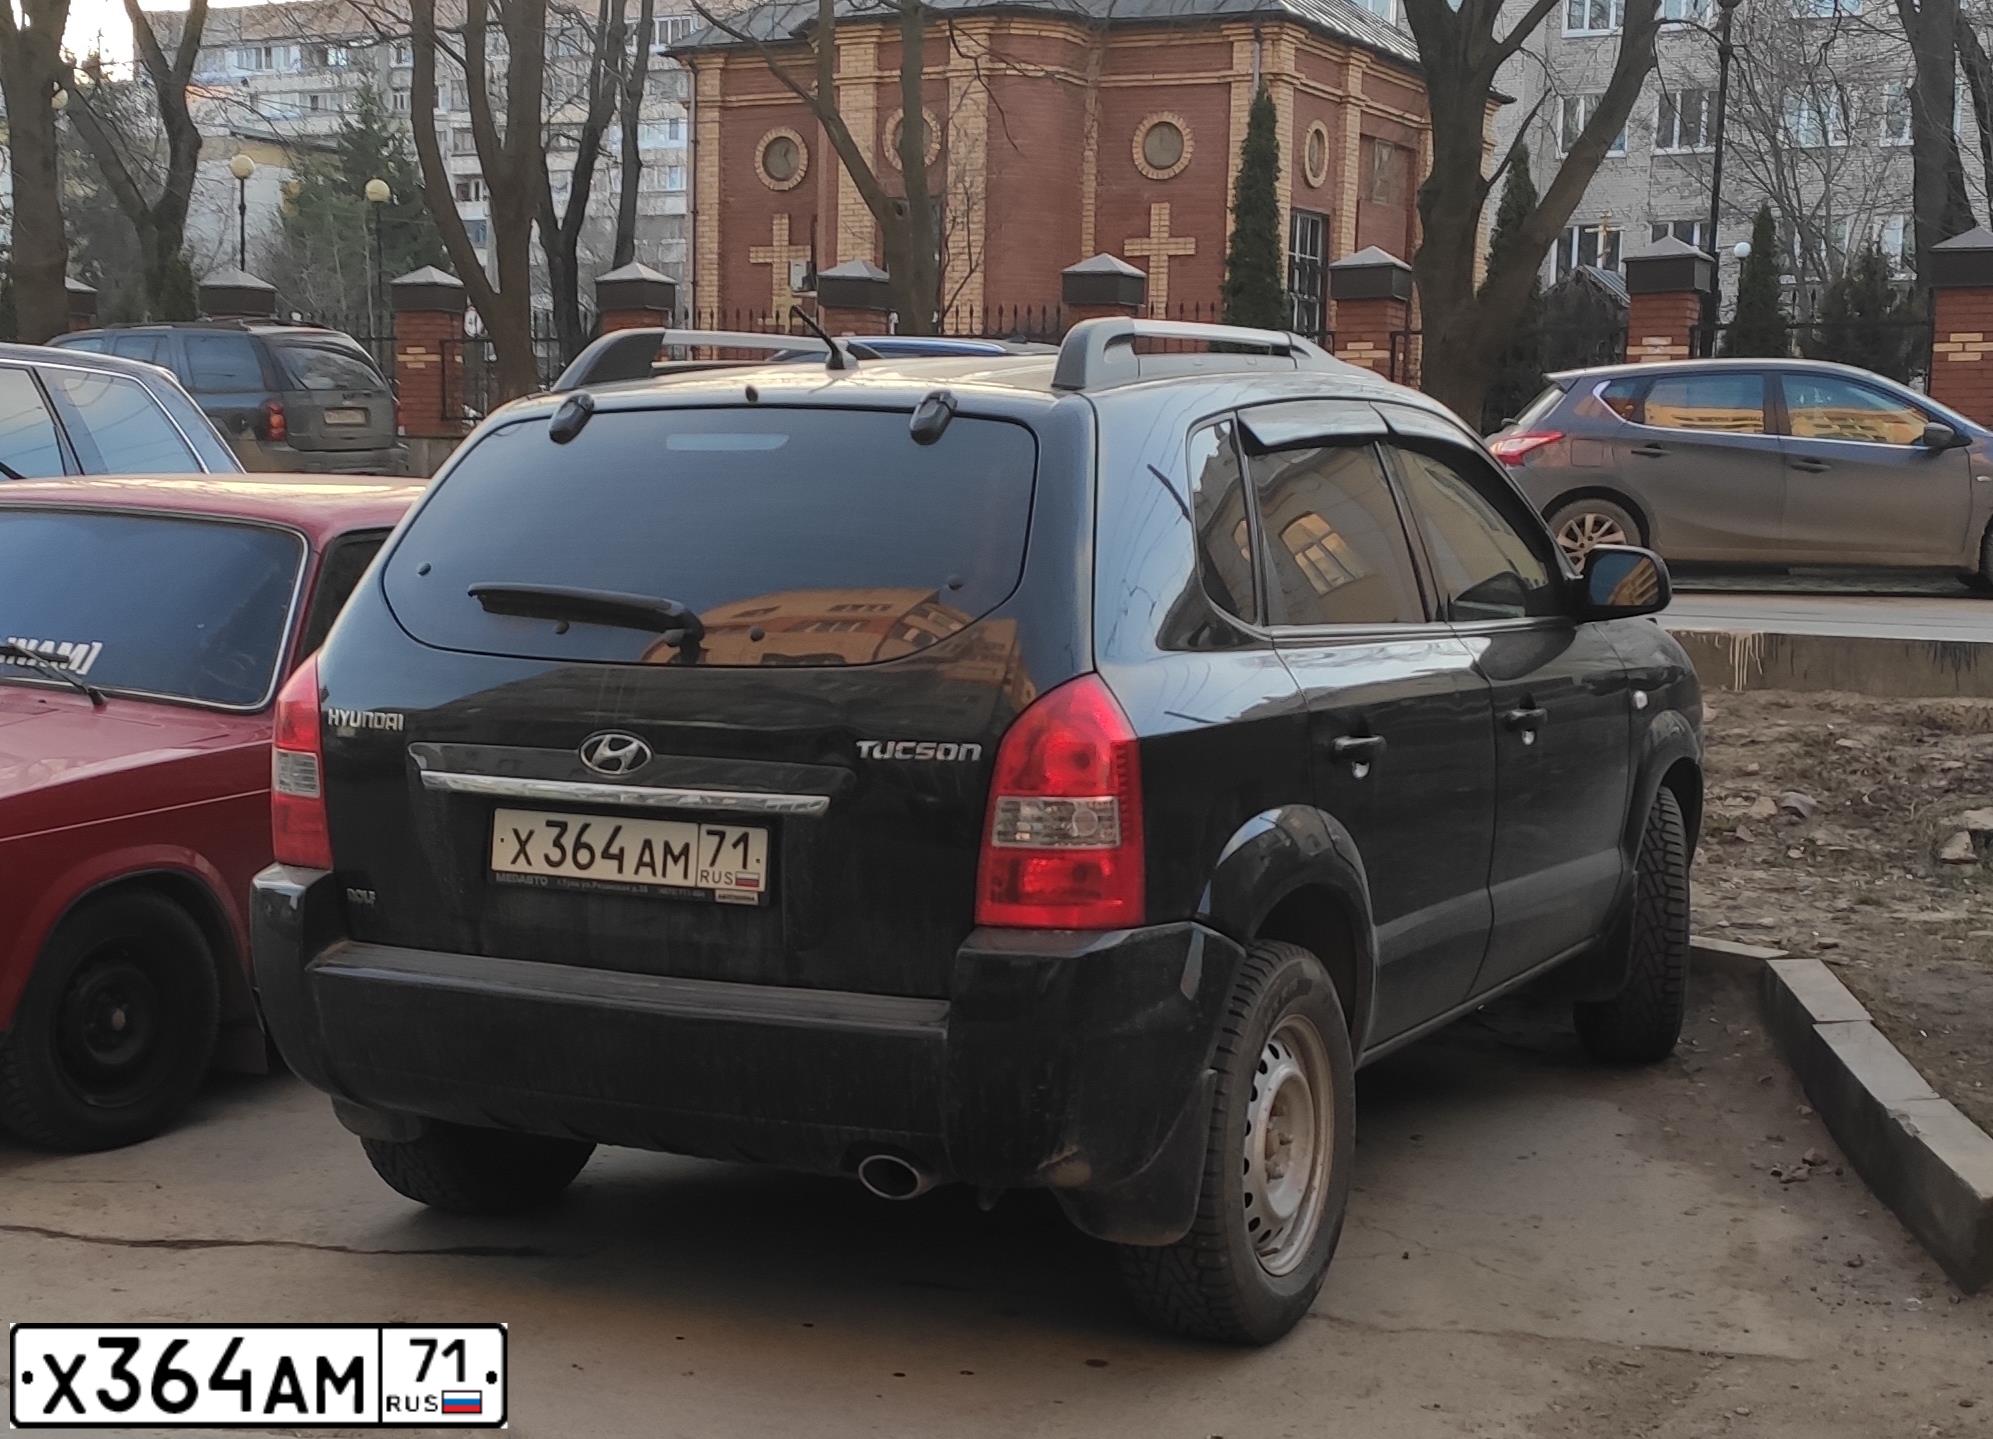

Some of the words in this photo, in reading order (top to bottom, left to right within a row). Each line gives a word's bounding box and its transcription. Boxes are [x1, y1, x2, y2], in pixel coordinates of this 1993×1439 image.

[328, 708, 404, 731] HYUNDAI
[855, 740, 982, 762] TUCSON
[705, 829, 749, 870] 71
[700, 870, 734, 886] RUS
